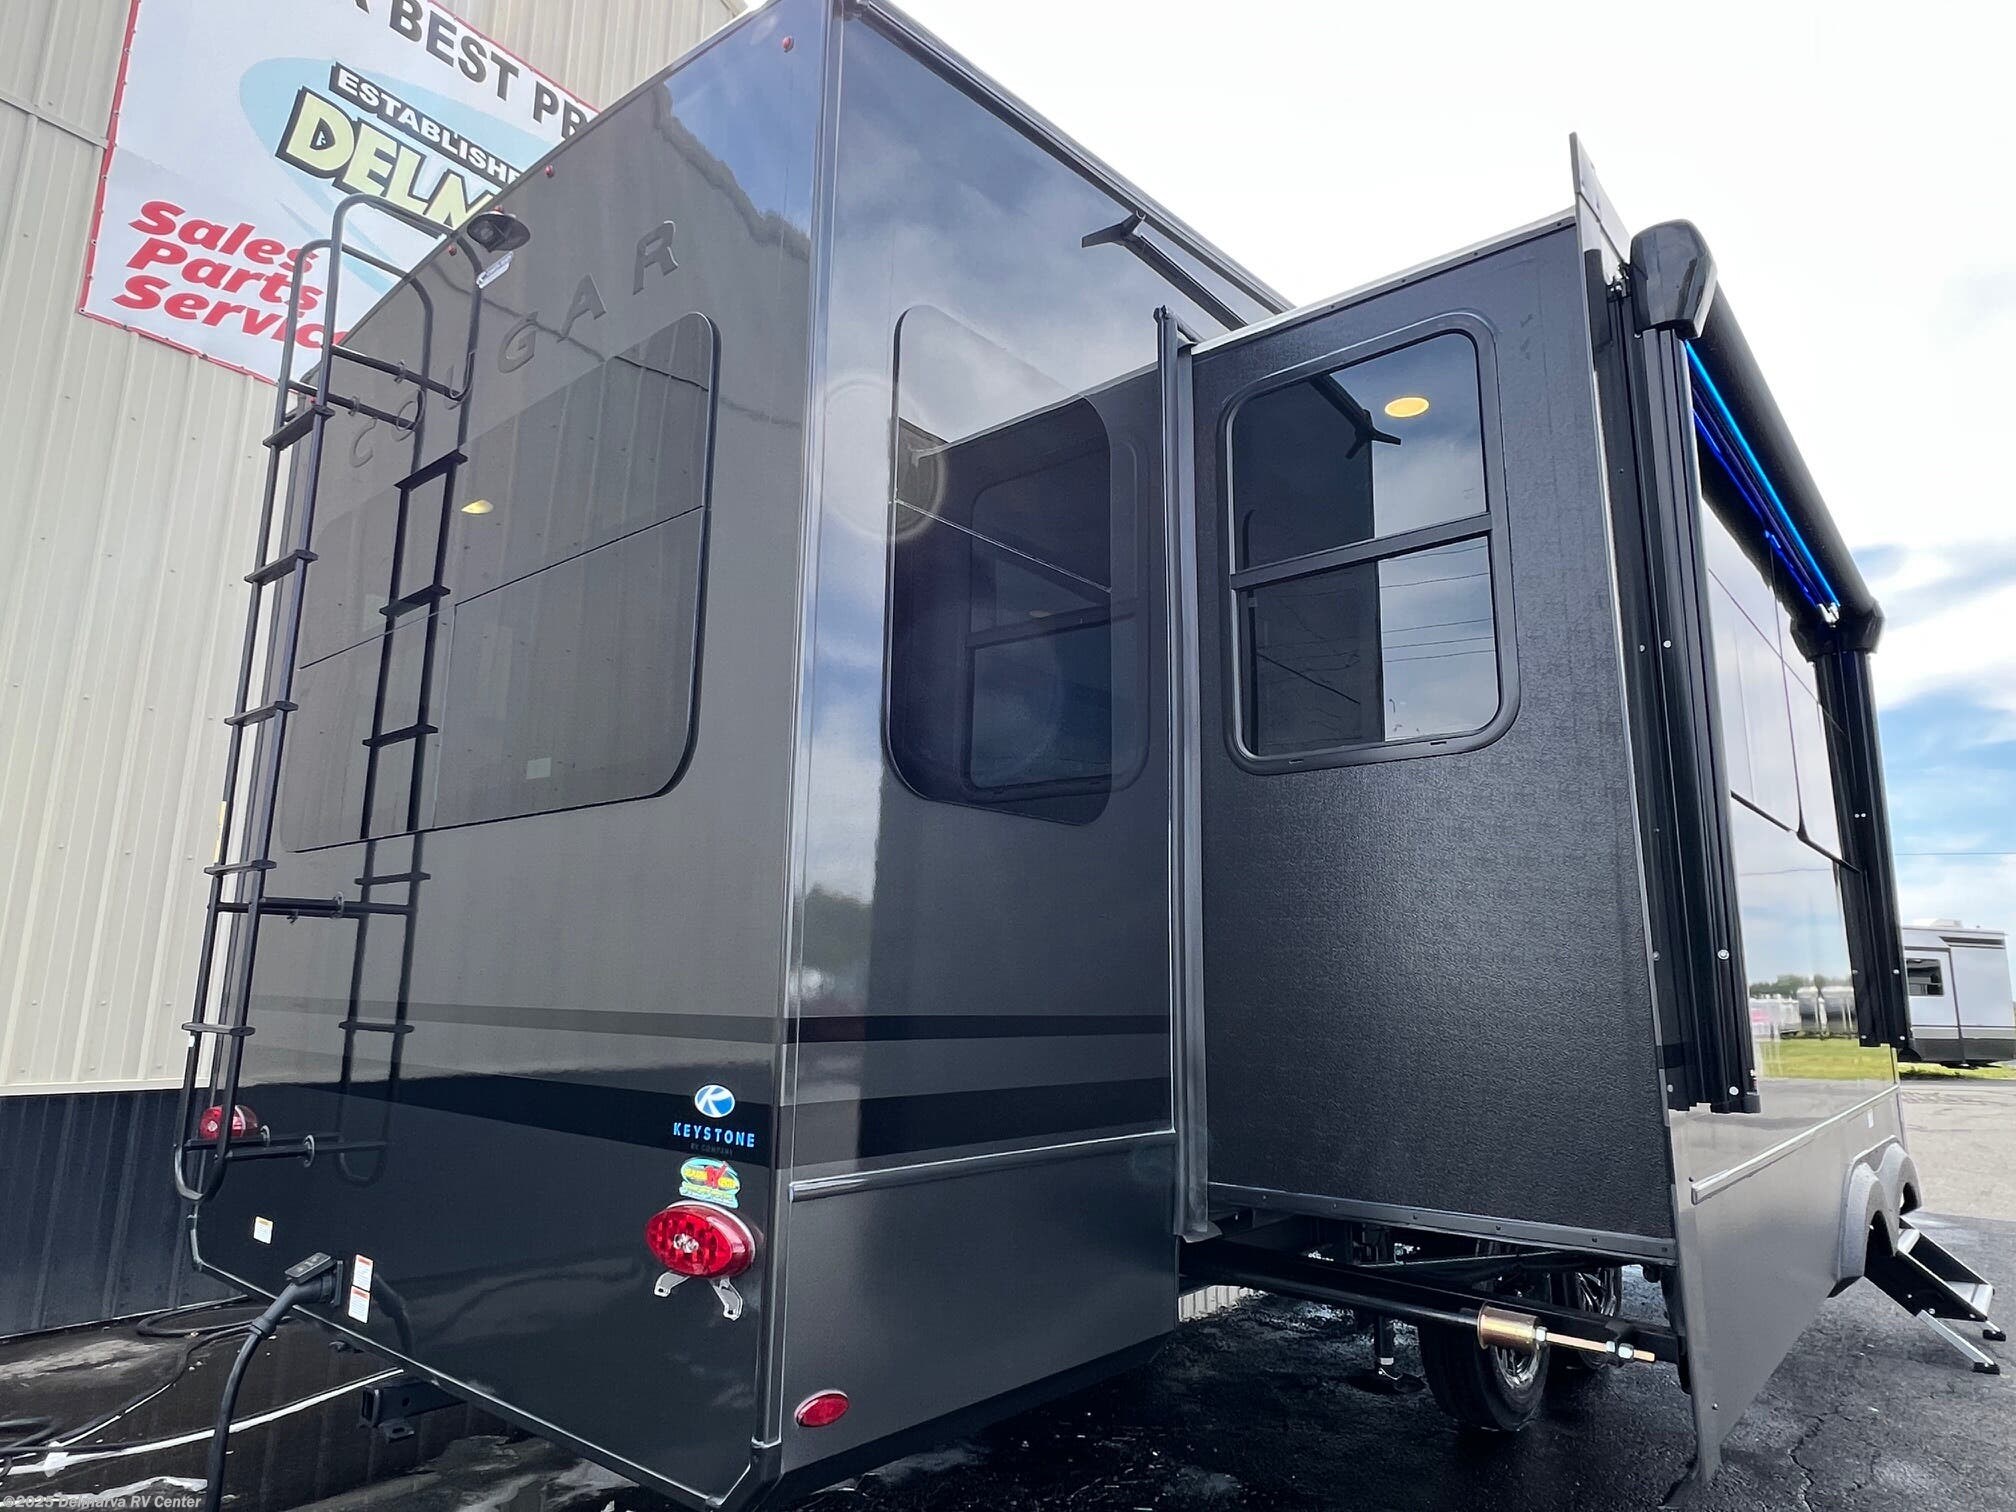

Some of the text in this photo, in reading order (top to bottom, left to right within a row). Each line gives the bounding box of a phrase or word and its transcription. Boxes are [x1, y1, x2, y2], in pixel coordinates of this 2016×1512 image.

[389, 0, 519, 101] BEST
[126, 237, 324, 311] Parts
[128, 200, 318, 274] Sales
[673, 1122, 755, 1148] KEYSTONE
